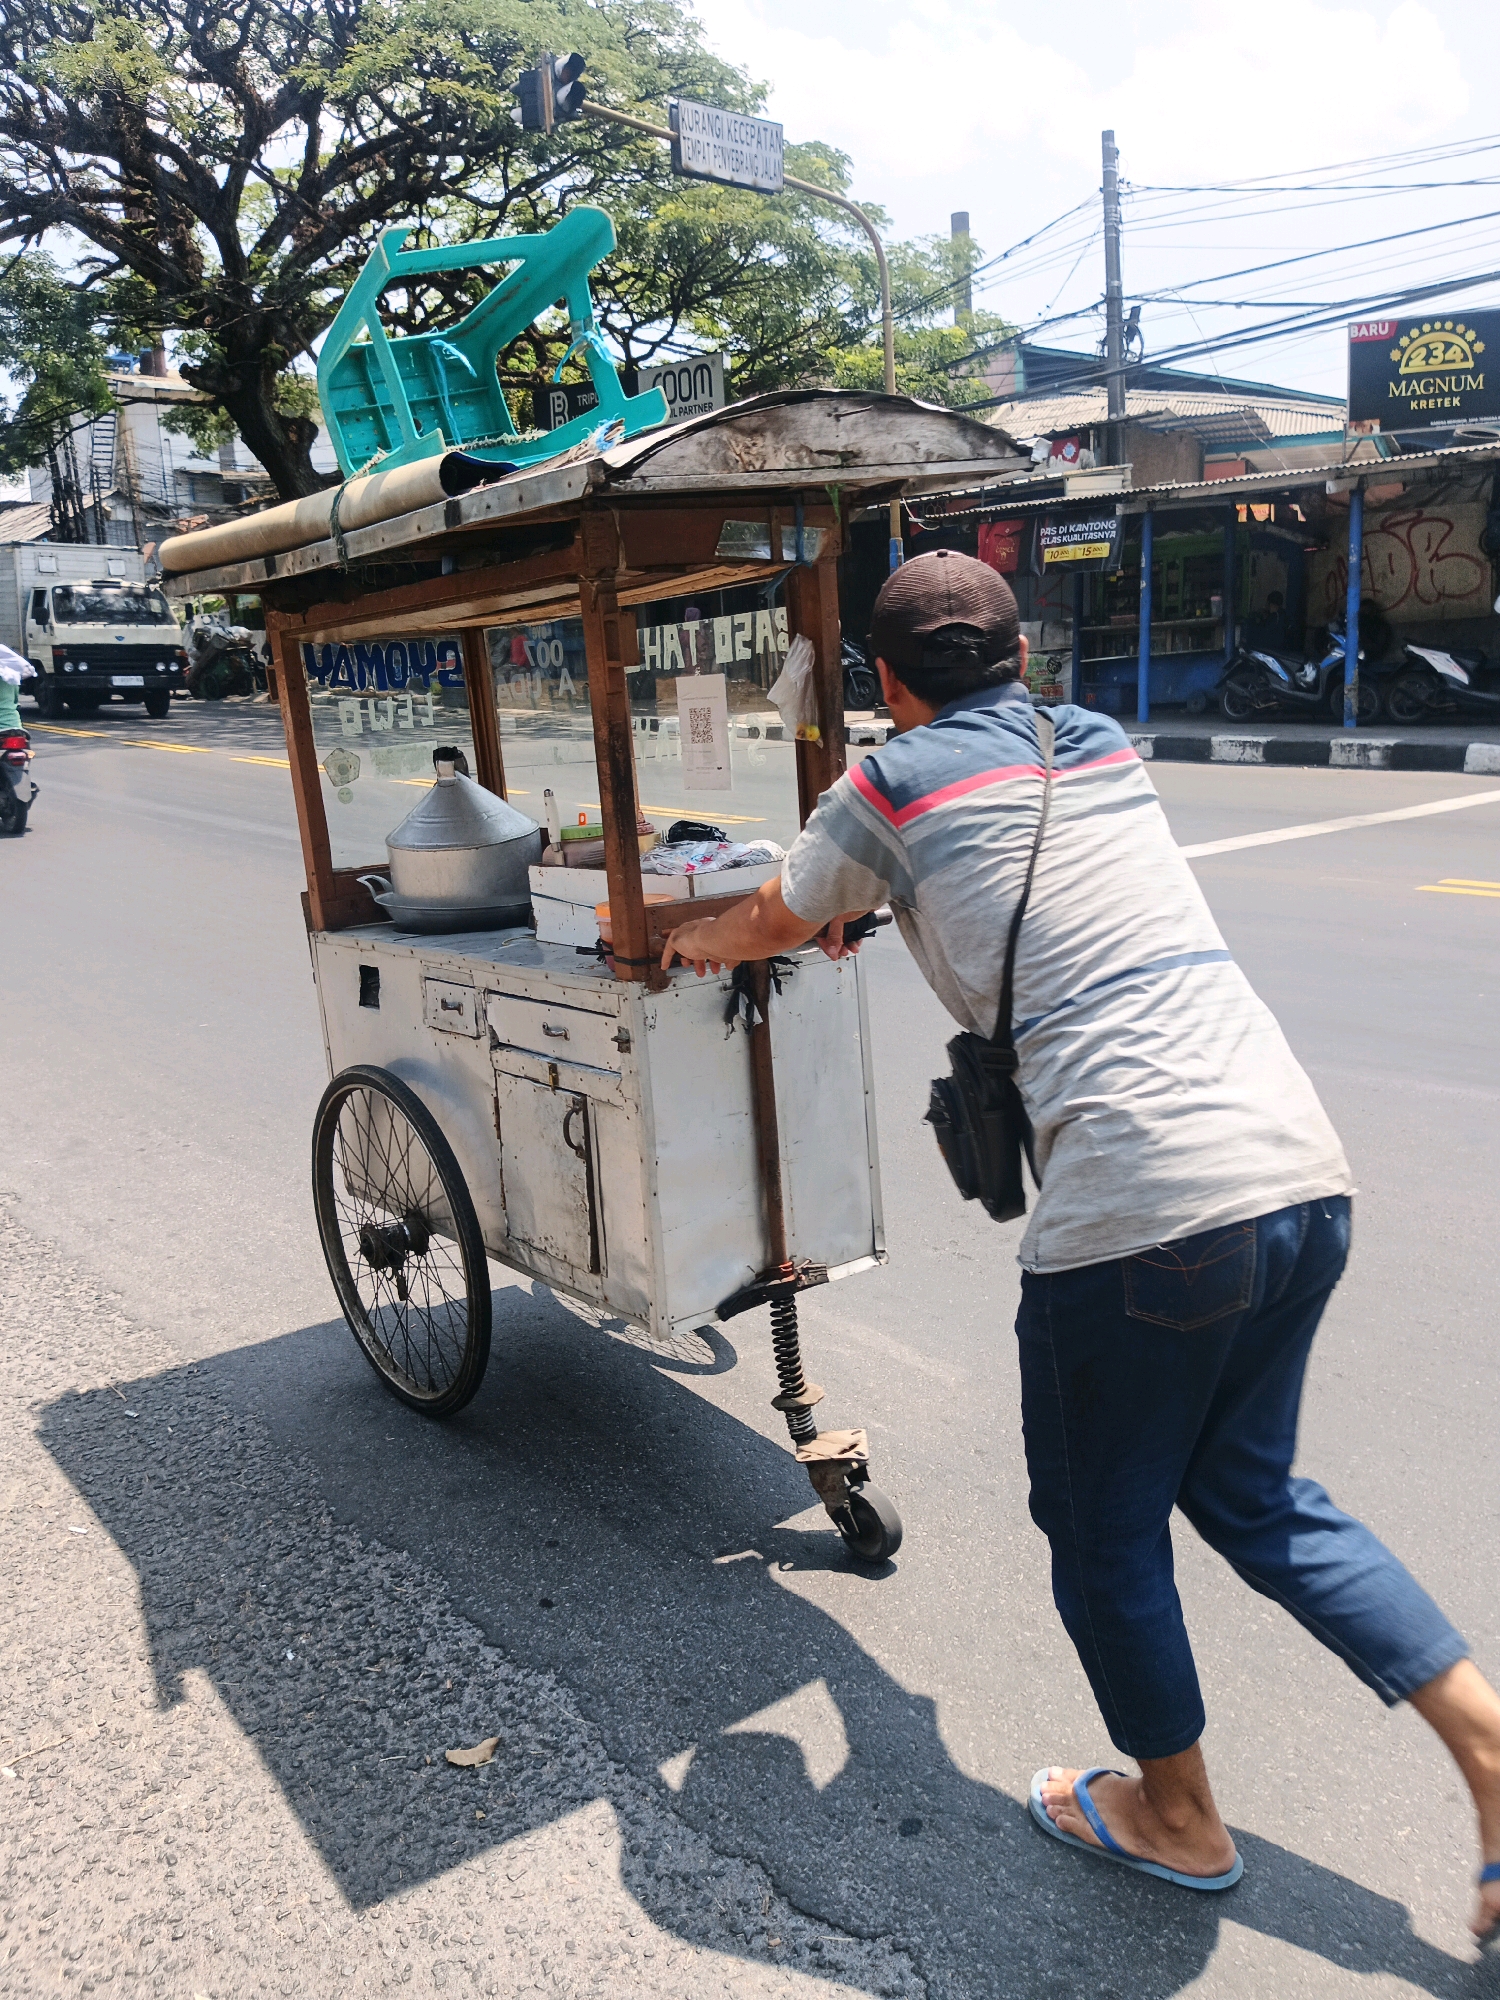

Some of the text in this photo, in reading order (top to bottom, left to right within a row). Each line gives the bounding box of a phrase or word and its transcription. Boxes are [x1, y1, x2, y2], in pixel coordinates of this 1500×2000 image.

[680, 106, 782, 155] KURANGI KECEPATAN
[681, 136, 782, 184] TEMPAT PENYEBRANG JALAN
[1350, 322, 1390, 339] BARU
[1408, 341, 1464, 368] 234
[1388, 373, 1485, 398] MAGNUM
[576, 392, 600, 407] TRIPL
[1410, 396, 1461, 411] KRETEK
[678, 402, 714, 417] PARTNER
[1040, 520, 1117, 537] PAS DI KANTONG
[1040, 530, 1117, 546] JELAS KUALITASNYA
